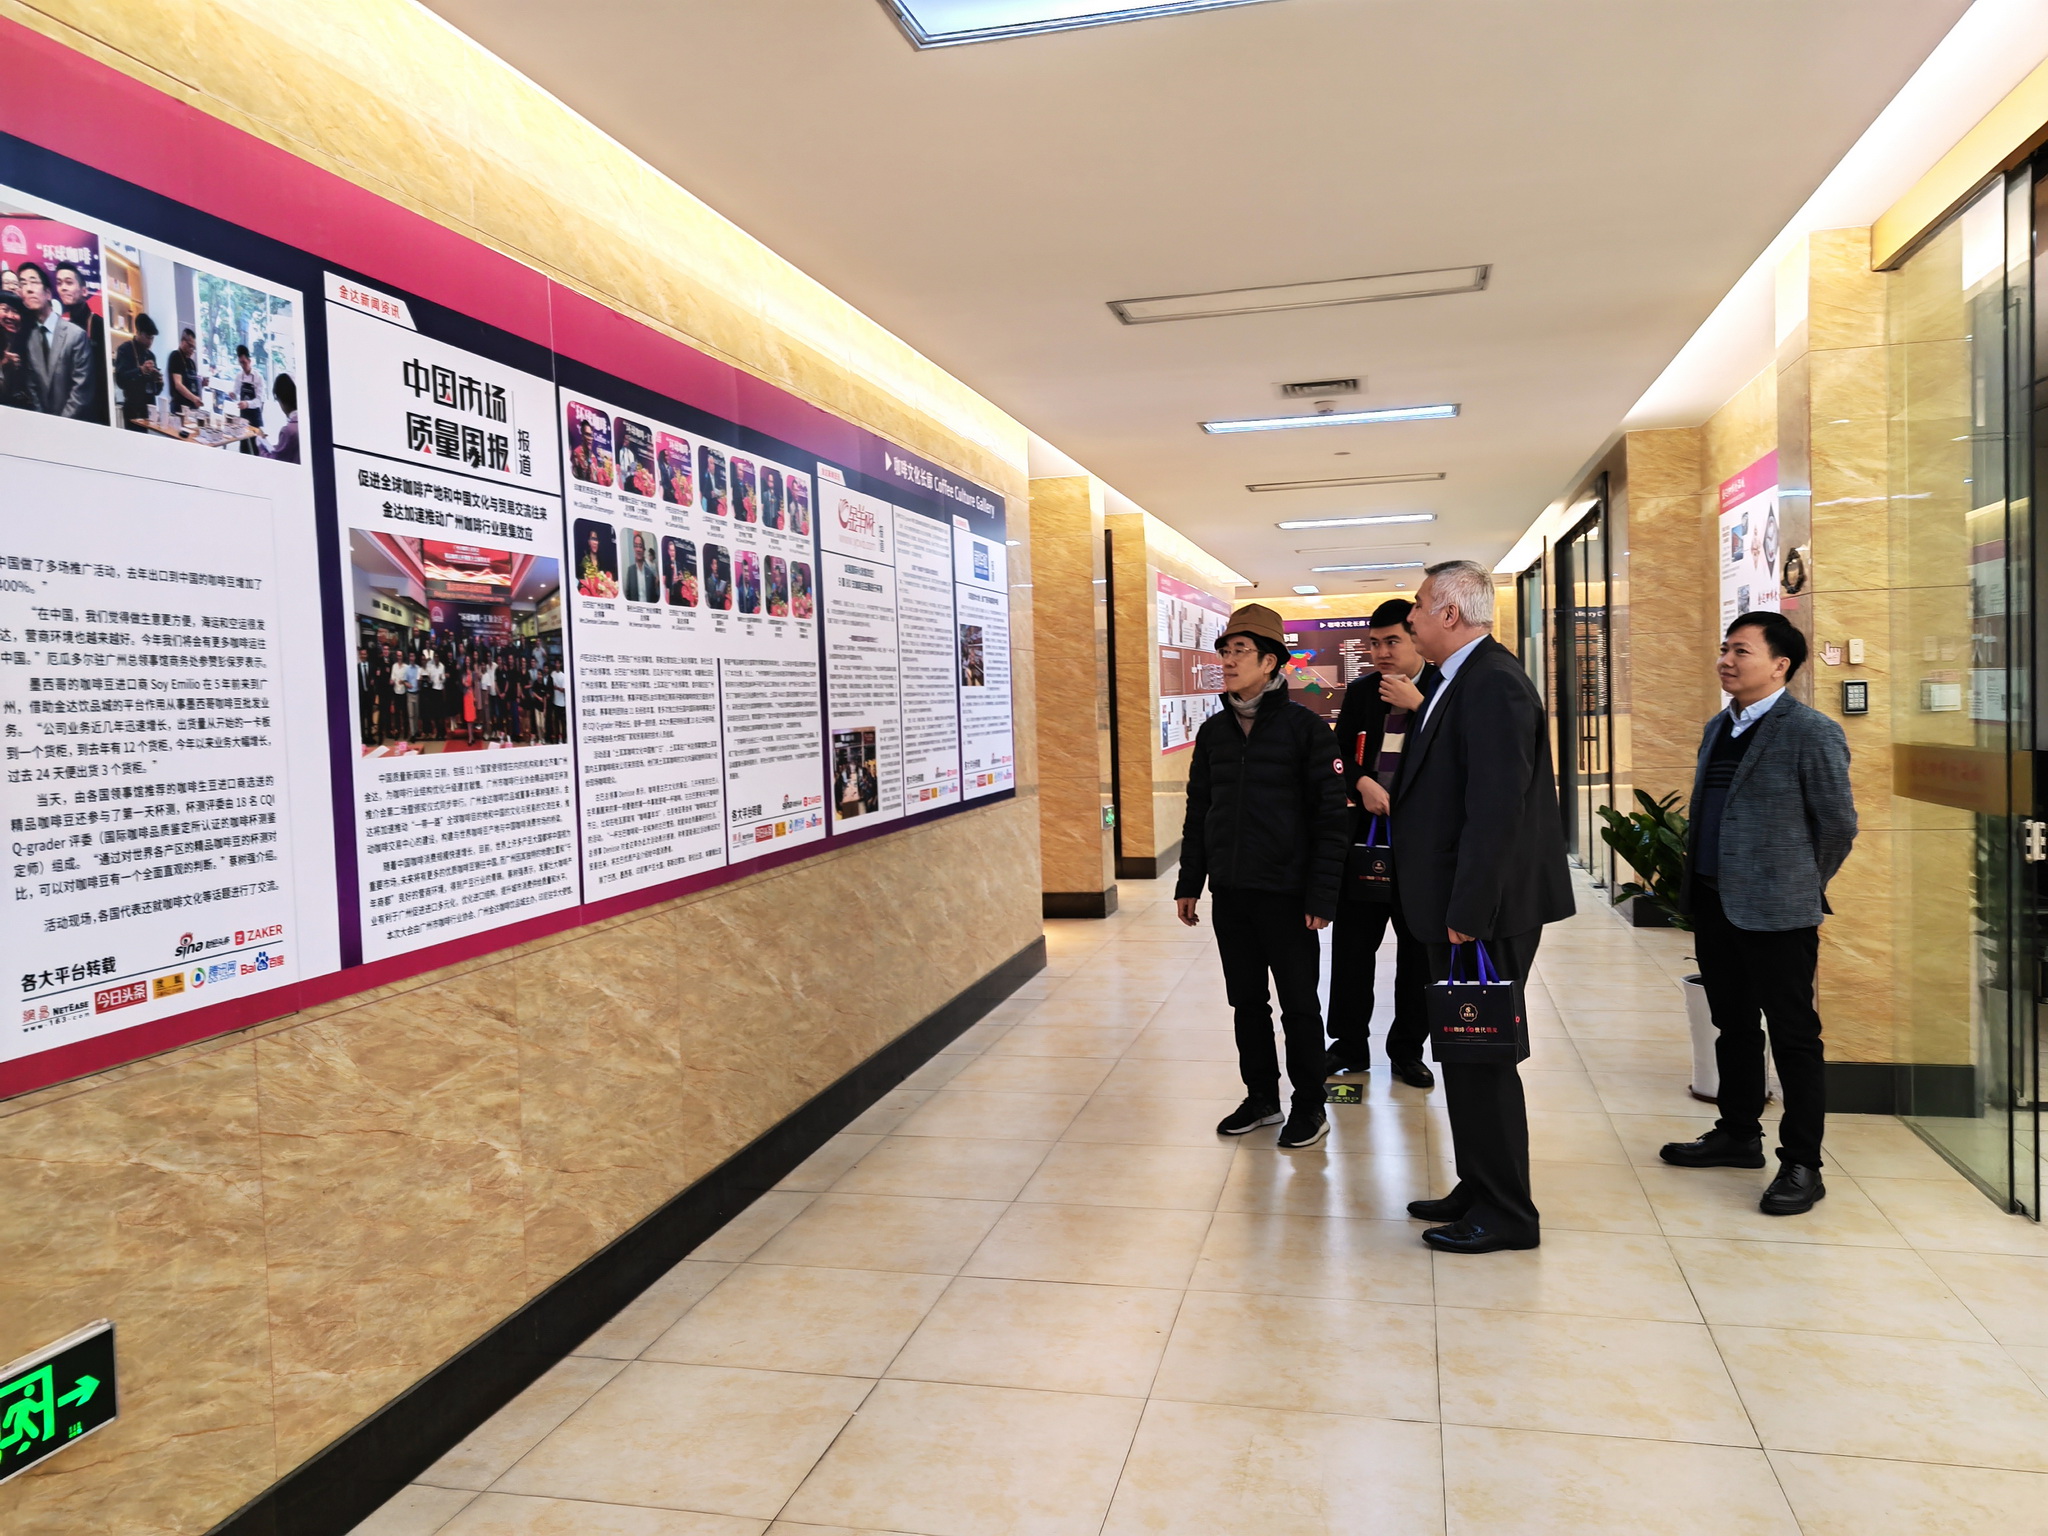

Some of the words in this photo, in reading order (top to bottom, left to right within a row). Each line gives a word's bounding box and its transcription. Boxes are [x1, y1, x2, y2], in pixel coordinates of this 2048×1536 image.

[339, 284, 400, 320] 金达新闻资讯
[402, 358, 507, 424] 中国市场
[406, 411, 510, 472] 质量周报
[518, 428, 532, 477] 报道
[358, 468, 548, 520] 促进全球咖啡产地和中国文化与贸易交流往来
[893, 456, 934, 490] 咖啡文化长廊
[934, 476, 954, 498] Coffee
[954, 486, 976, 508] Culture
[976, 496, 995, 518] Gallery
[382, 500, 534, 542] 金达加速推动广州咖啡行业聚集效应
[30, 678, 148, 692] 墨西哥的咖啡豆进口商
[150, 678, 169, 692] Soy
[170, 678, 202, 690] Emilio
[124, 742, 138, 754] 12
[8, 768, 34, 784] 过去
[36, 768, 50, 780] 24
[52, 764, 100, 780] 天便出货
[102, 764, 108, 776] 3
[236, 796, 248, 808] 18
[260, 794, 276, 806] CQI
[12, 838, 66, 856] Q-grader
[174, 936, 204, 960] sina
[246, 924, 283, 942] ZAKER
[21, 956, 118, 993] 各大平台转载
[96, 983, 146, 1008] 今日头条
